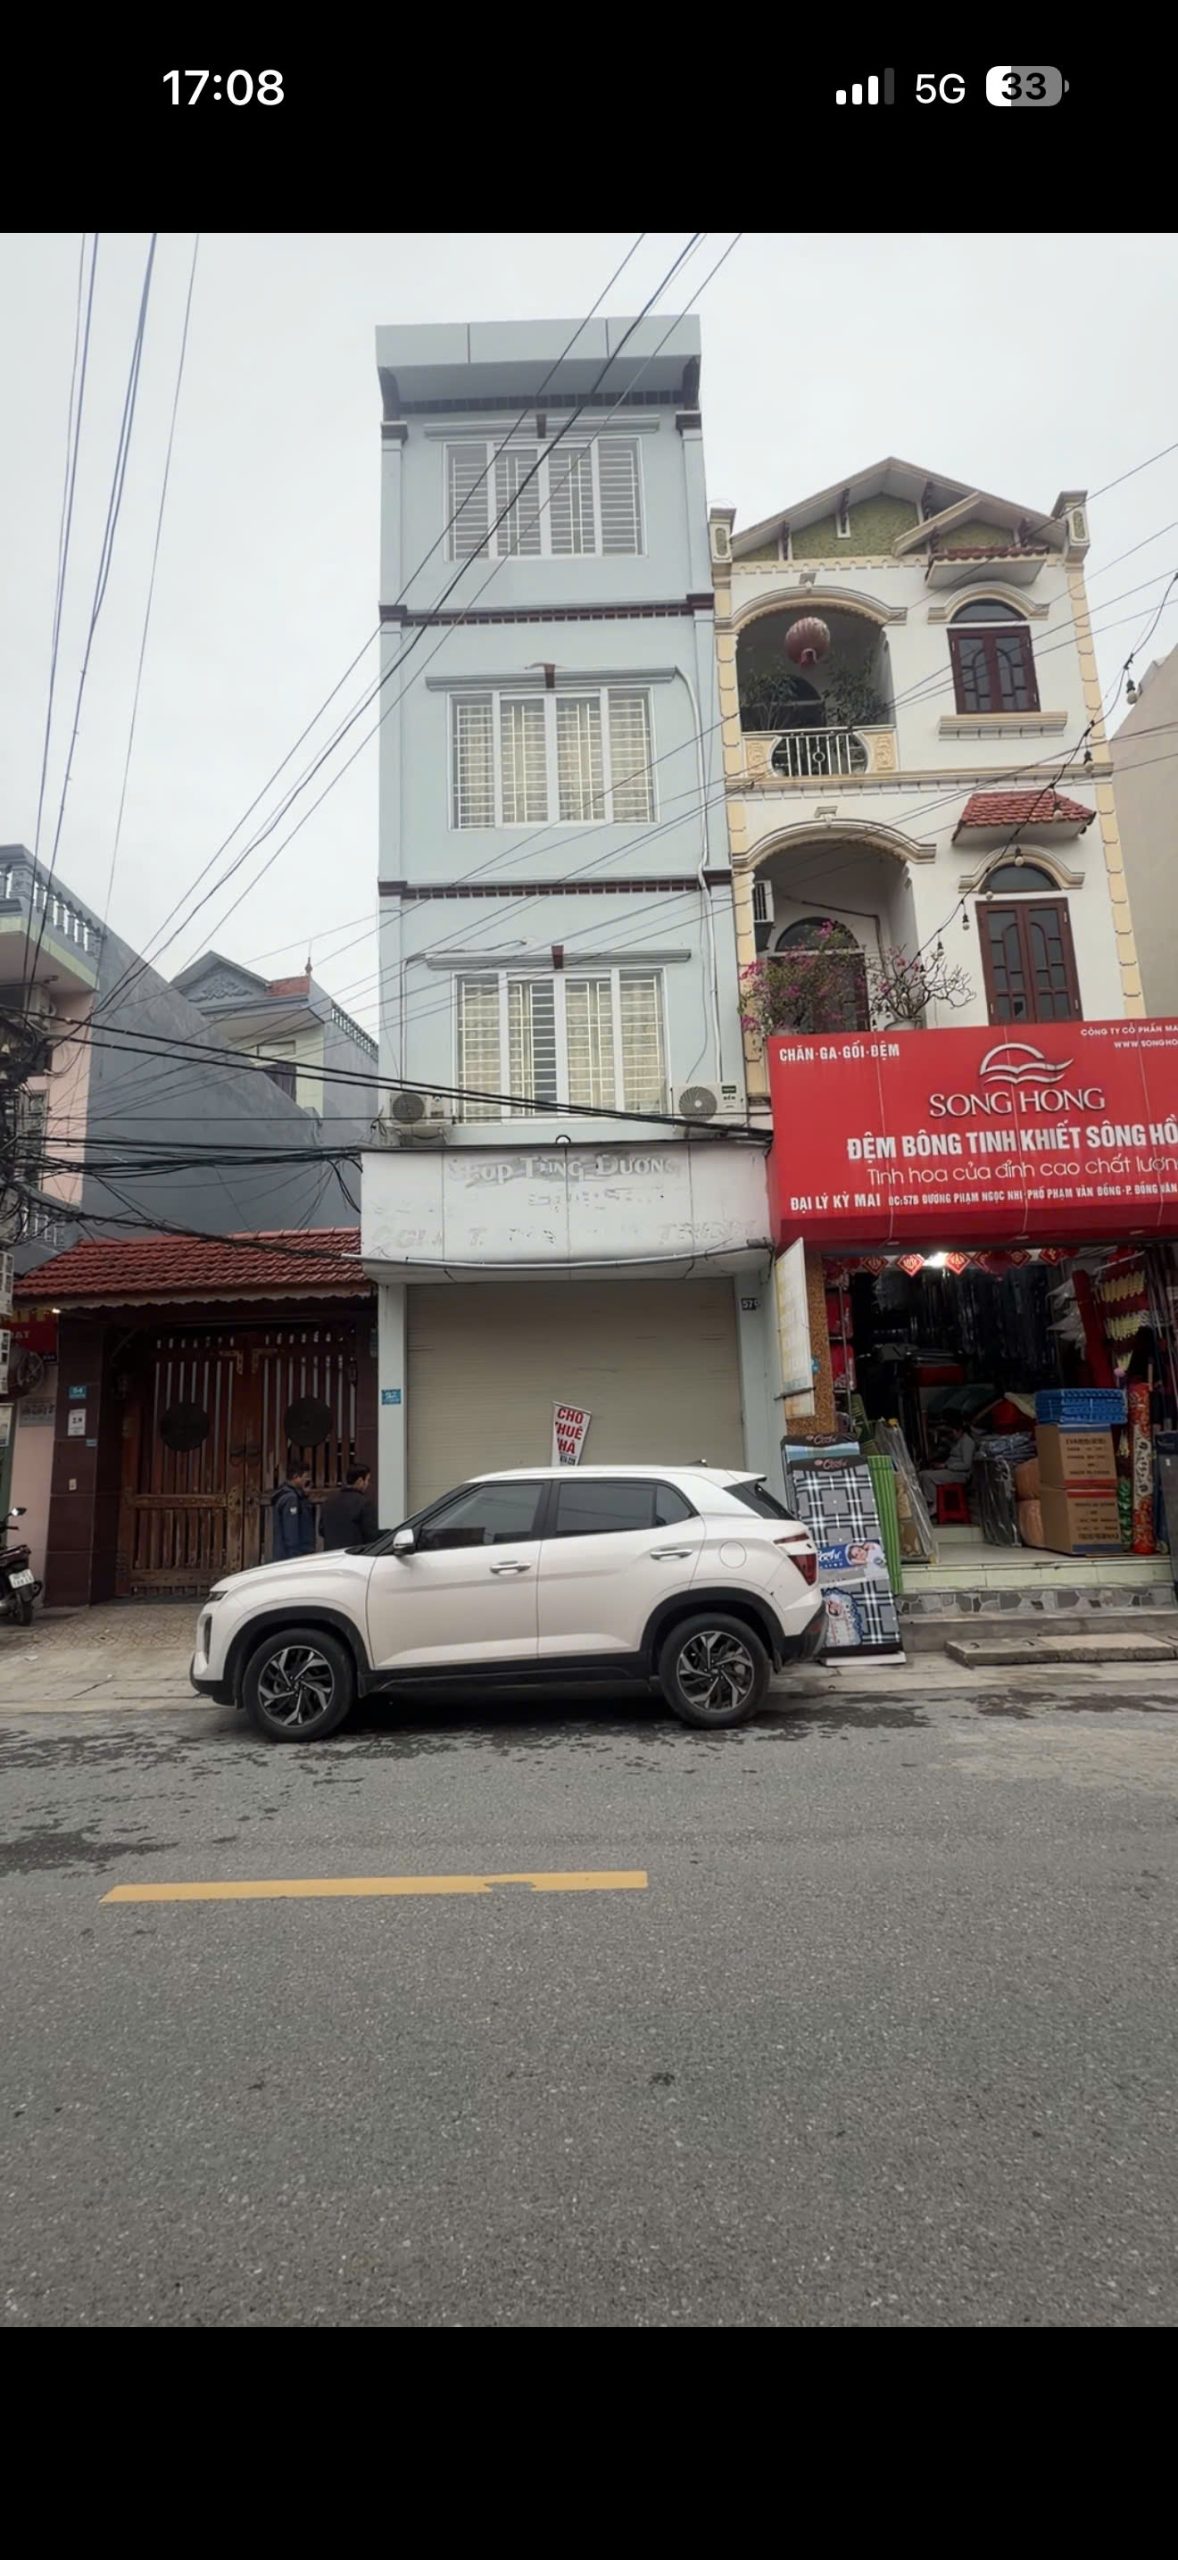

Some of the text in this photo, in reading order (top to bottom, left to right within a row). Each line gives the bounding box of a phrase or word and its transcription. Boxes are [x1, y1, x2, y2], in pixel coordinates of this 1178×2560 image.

[929, 1087, 1106, 1118] SONG HONG
[847, 1131, 897, 1164] ĐỆM
[901, 1128, 963, 1158] BÔNG
[965, 1129, 1017, 1155] TINH
[1020, 1119, 1081, 1152] KHIẾT
[1086, 1120, 1147, 1149] SÔNG
[867, 1153, 1178, 1186] Tinh hoa của đỉnh cao chất lượn
[790, 1196, 812, 1214] ĐẠI
[854, 1193, 881, 1207] MAI
[953, 1192, 979, 1206] PHẠM
[557, 1406, 584, 1424] CHO
[555, 1422, 583, 1441] HUÊ
[557, 1438, 576, 1454] HÀ
